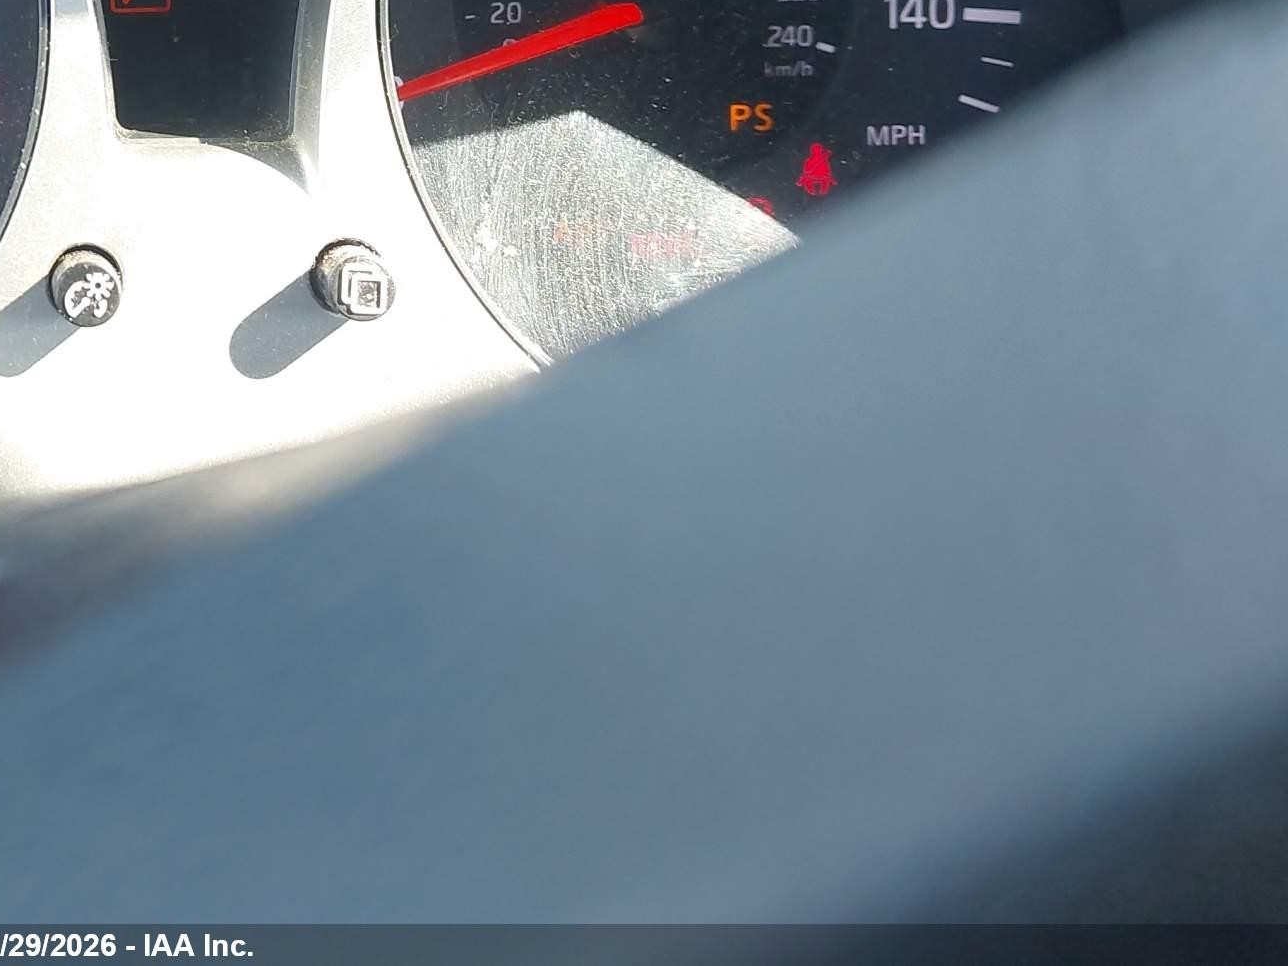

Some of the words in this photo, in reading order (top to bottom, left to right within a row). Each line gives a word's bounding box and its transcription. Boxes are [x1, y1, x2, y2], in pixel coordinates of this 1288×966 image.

[491, 2, 521, 24] 20
[767, 25, 814, 47] 240
[729, 104, 773, 130] PS
[868, 125, 926, 145] MPH
